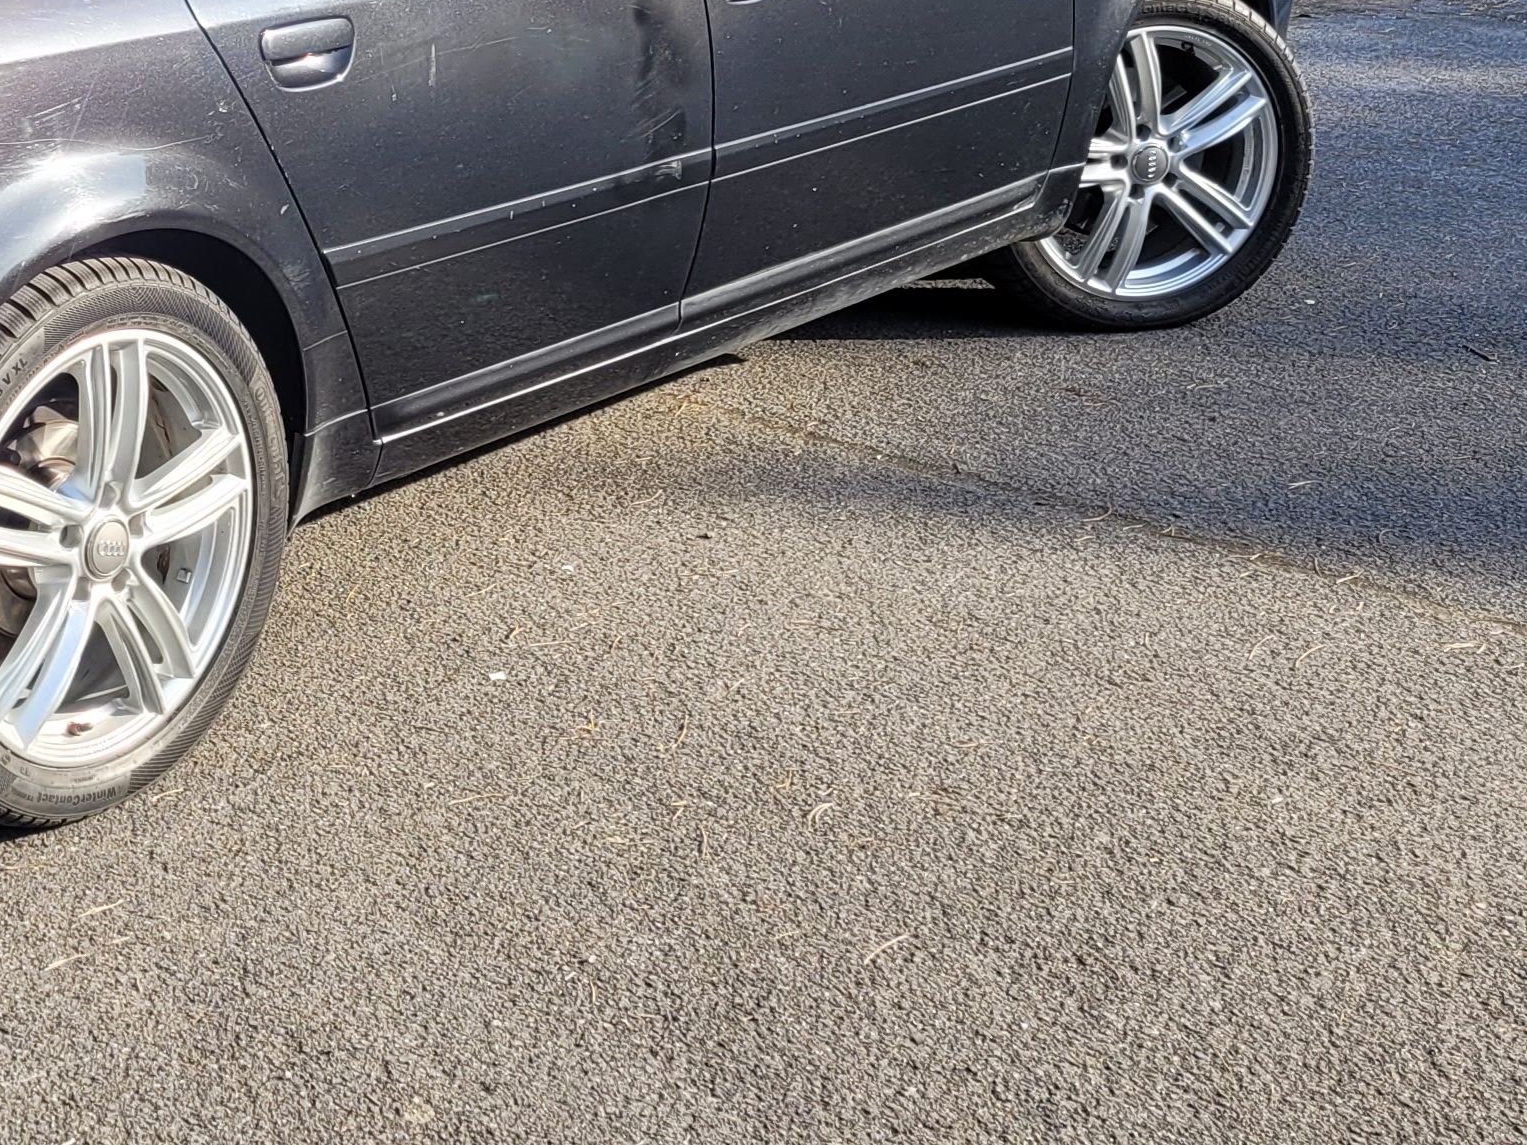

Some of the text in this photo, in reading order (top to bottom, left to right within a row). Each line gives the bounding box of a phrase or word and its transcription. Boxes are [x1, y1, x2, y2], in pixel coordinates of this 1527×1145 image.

[2, 374, 12, 386] V
[11, 357, 29, 377] XL
[36, 787, 117, 806] WinterContact
